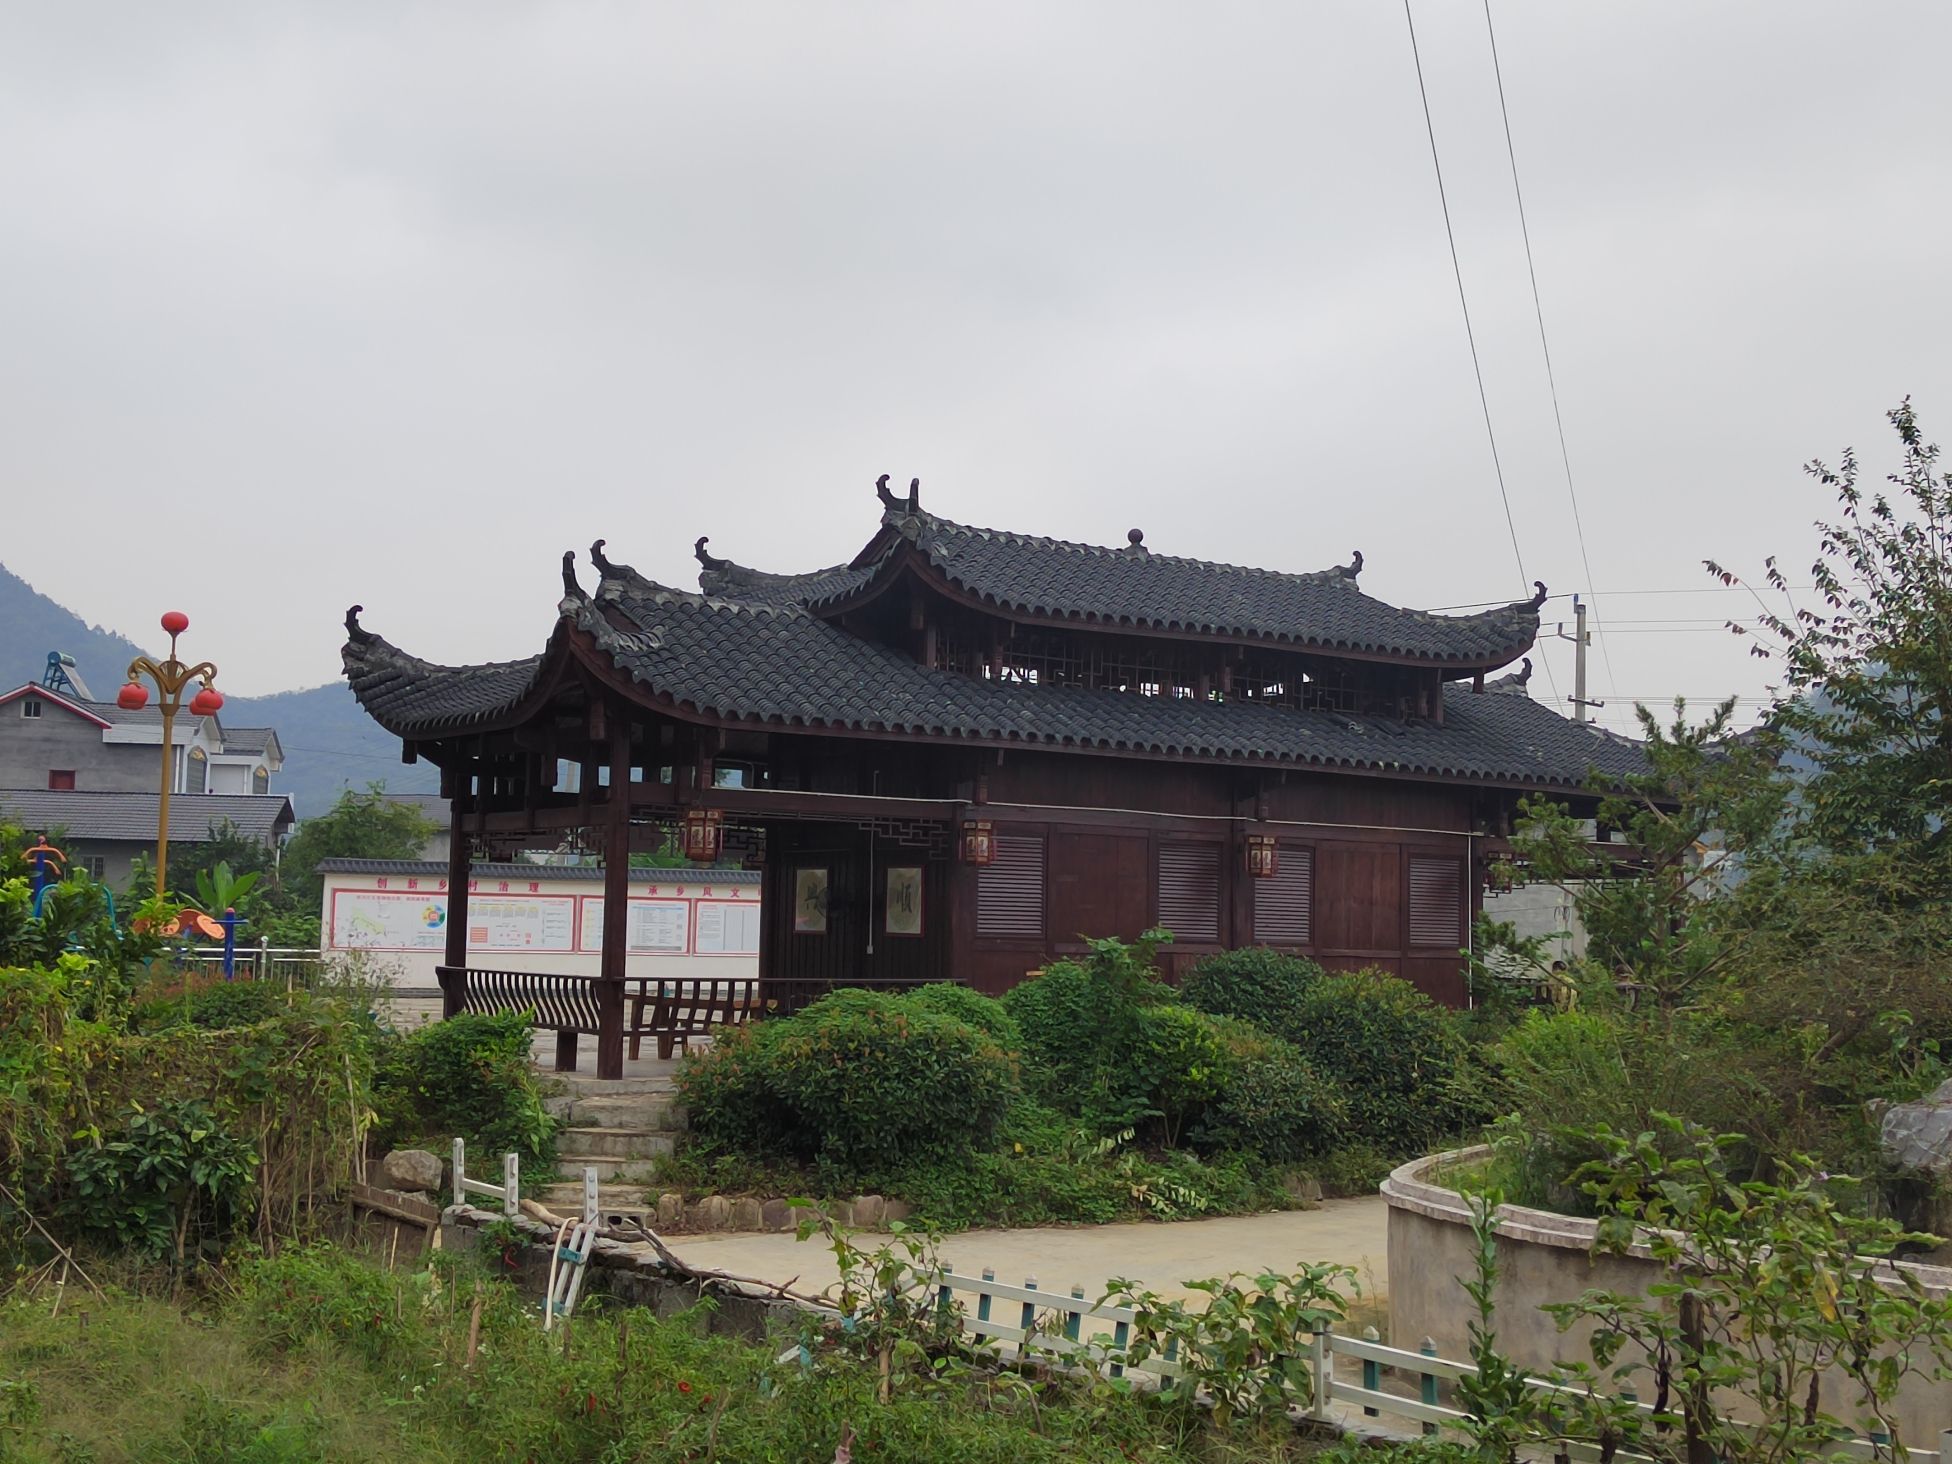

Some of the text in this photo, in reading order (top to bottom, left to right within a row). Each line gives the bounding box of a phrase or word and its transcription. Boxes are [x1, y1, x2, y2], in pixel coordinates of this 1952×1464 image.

[377, 877, 540, 893] 创新乡村治理
